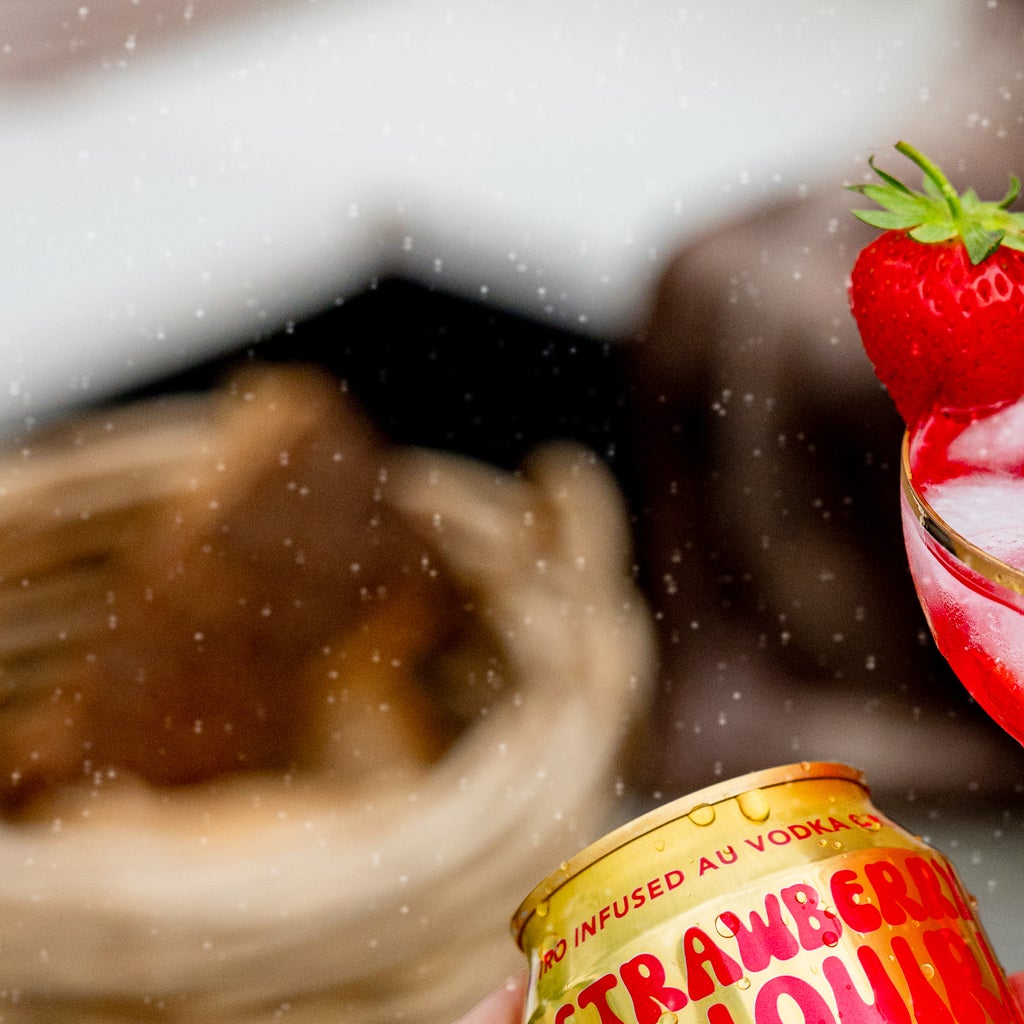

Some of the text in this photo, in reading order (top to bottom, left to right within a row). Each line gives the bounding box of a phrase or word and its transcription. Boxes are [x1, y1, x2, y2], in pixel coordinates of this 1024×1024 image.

[574, 869, 685, 948] INFUSED
[698, 845, 739, 877] AU
[744, 816, 851, 852] VODKA
